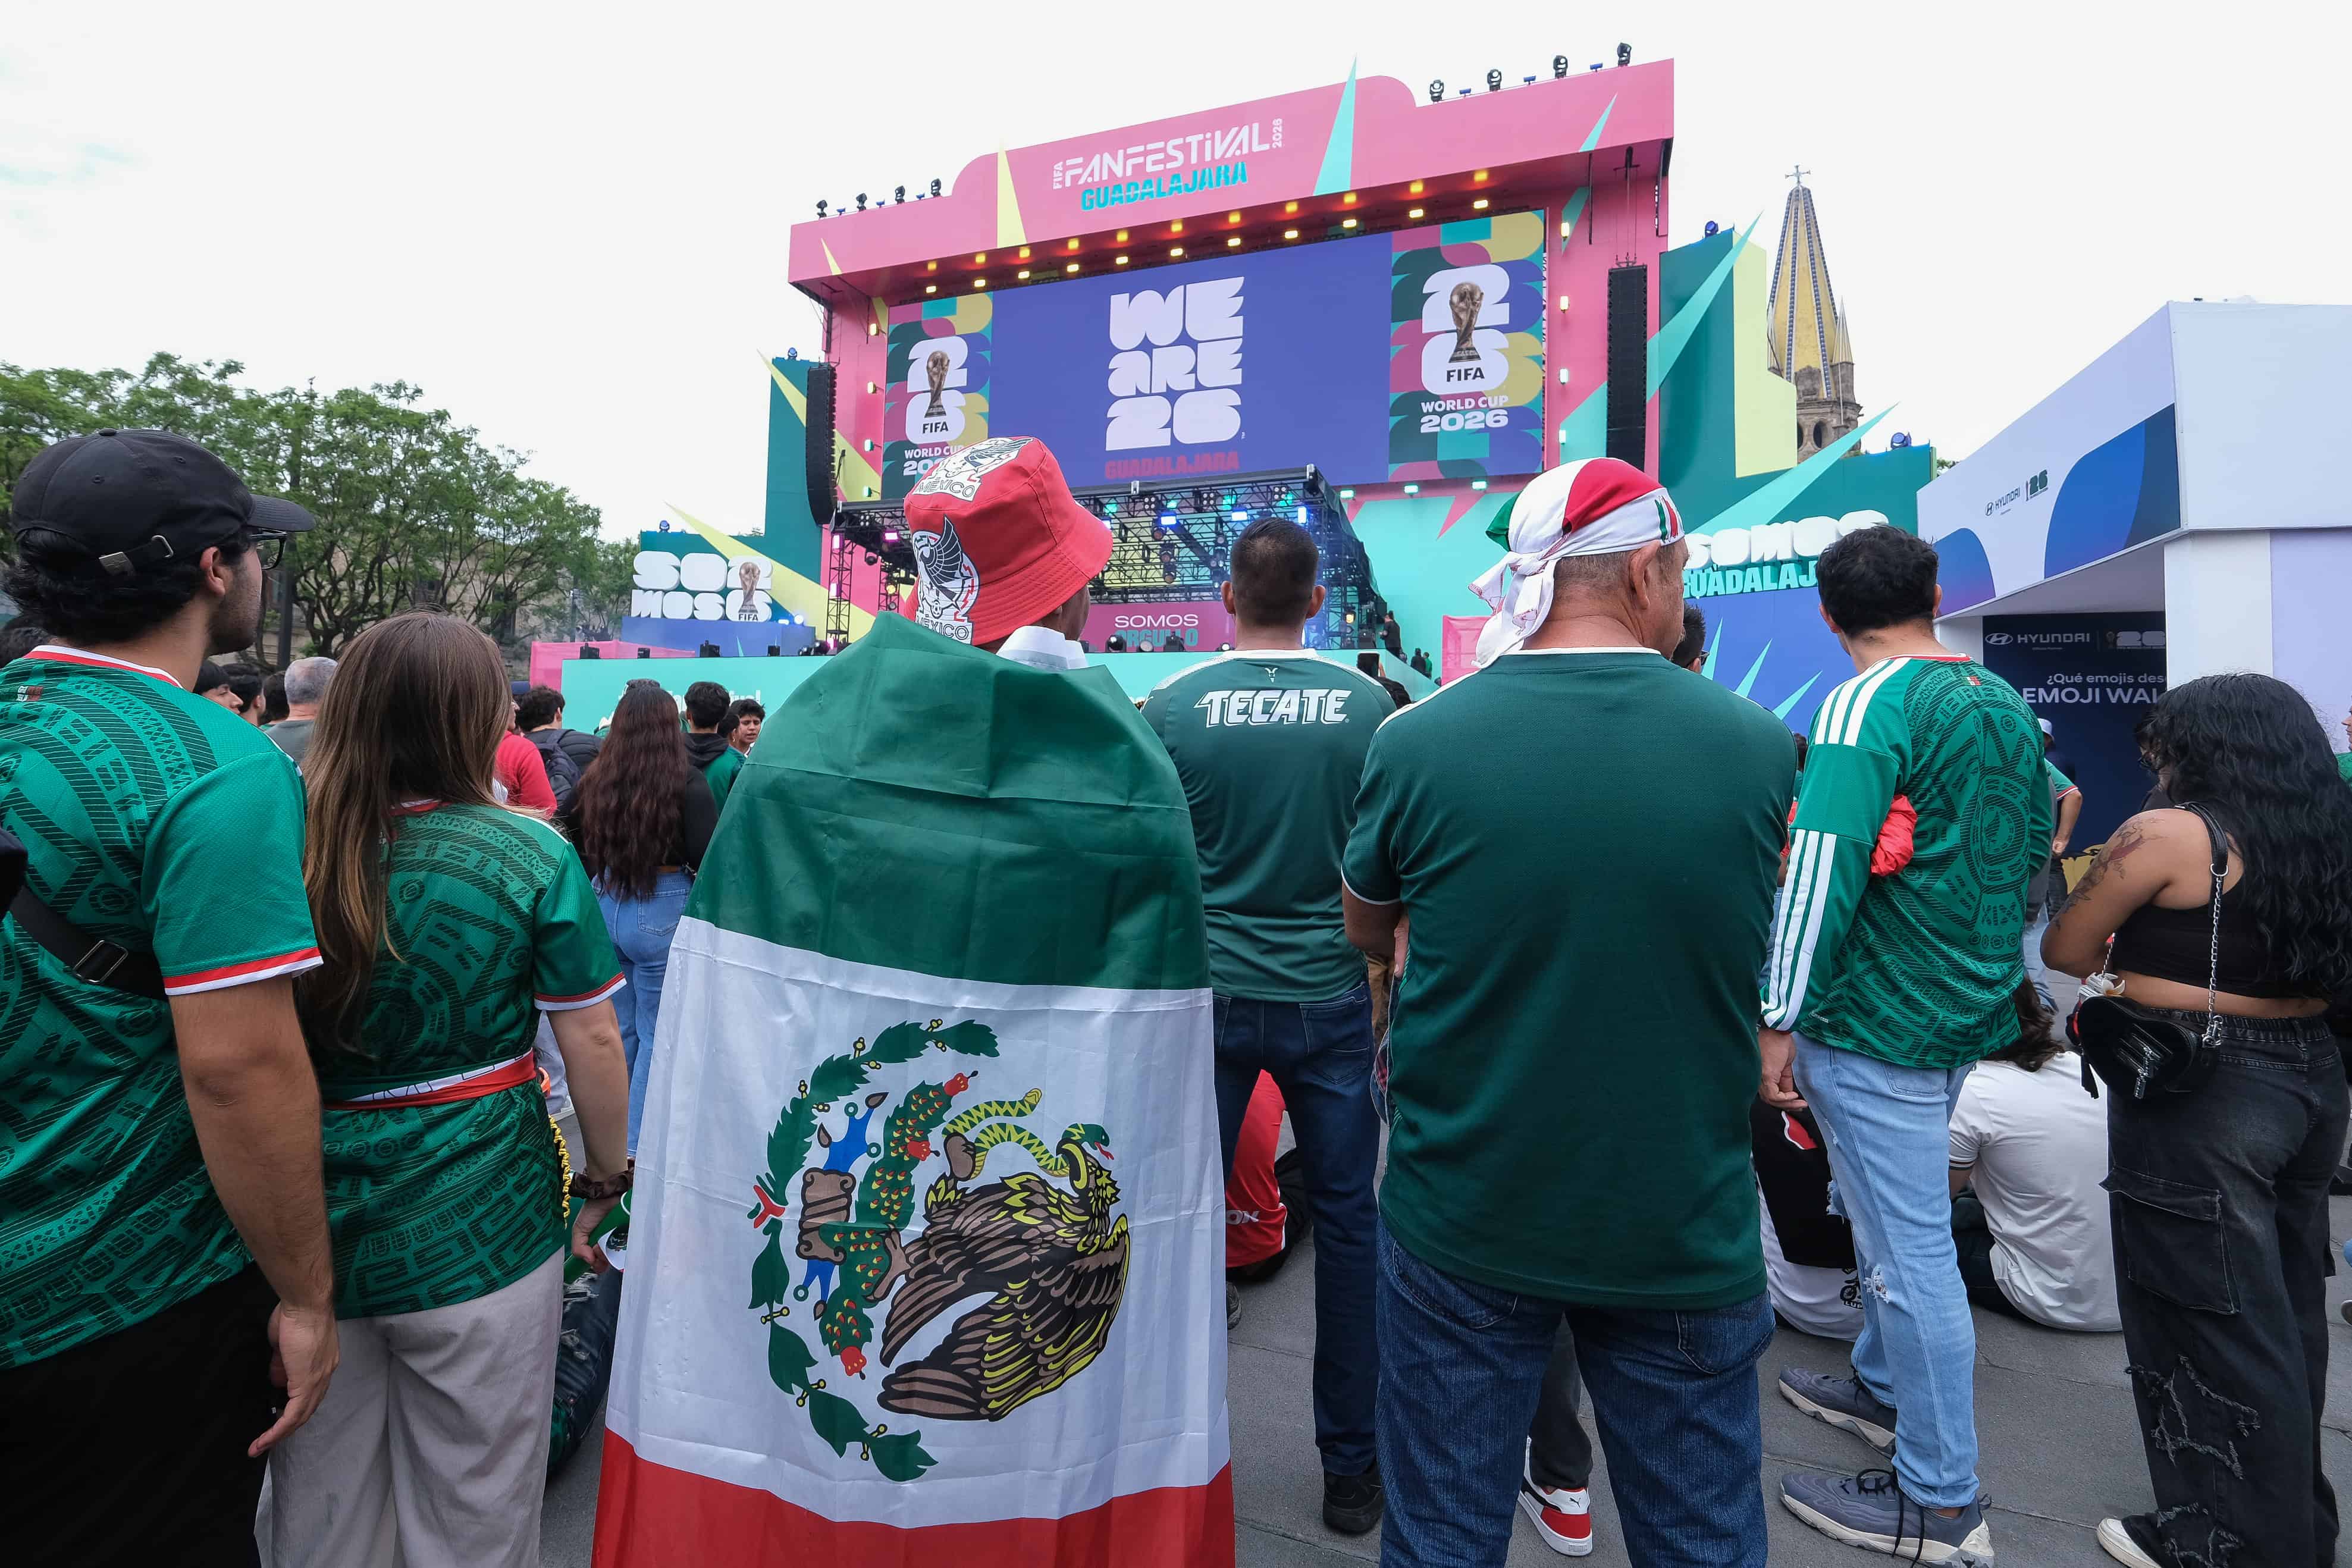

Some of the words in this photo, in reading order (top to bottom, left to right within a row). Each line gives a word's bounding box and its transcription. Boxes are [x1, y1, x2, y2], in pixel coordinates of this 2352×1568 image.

[1272, 118, 1283, 148] 2026
[1052, 161, 1064, 189] FIFA
[1080, 162, 1248, 211] GUADALAJARA
[1109, 276, 1245, 350] WE
[1446, 367, 1485, 382] FIFA
[1420, 398, 1476, 413] WORLD
[1478, 394, 1509, 410] CUP
[922, 421, 949, 434] FIFA
[1106, 388, 1242, 451] 26
[1420, 409, 1509, 434] 2026
[904, 447, 942, 459] WORLD
[1105, 451, 1240, 479] GUADALAJARA
[915, 476, 976, 498] MÉXICO
[2029, 469, 2049, 496] 26
[1995, 487, 2021, 510] HYUNDAI
[738, 613, 758, 622] FIFA
[1114, 614, 1199, 628] SOMOS
[2017, 633, 2090, 643] HYUNDAI
[2046, 672, 2083, 685] ¿Qué
[2086, 673, 2134, 685] emojis
[2138, 673, 2166, 683] des
[2022, 688, 2100, 703] EMOJI
[1193, 689, 1352, 729] TECATE
